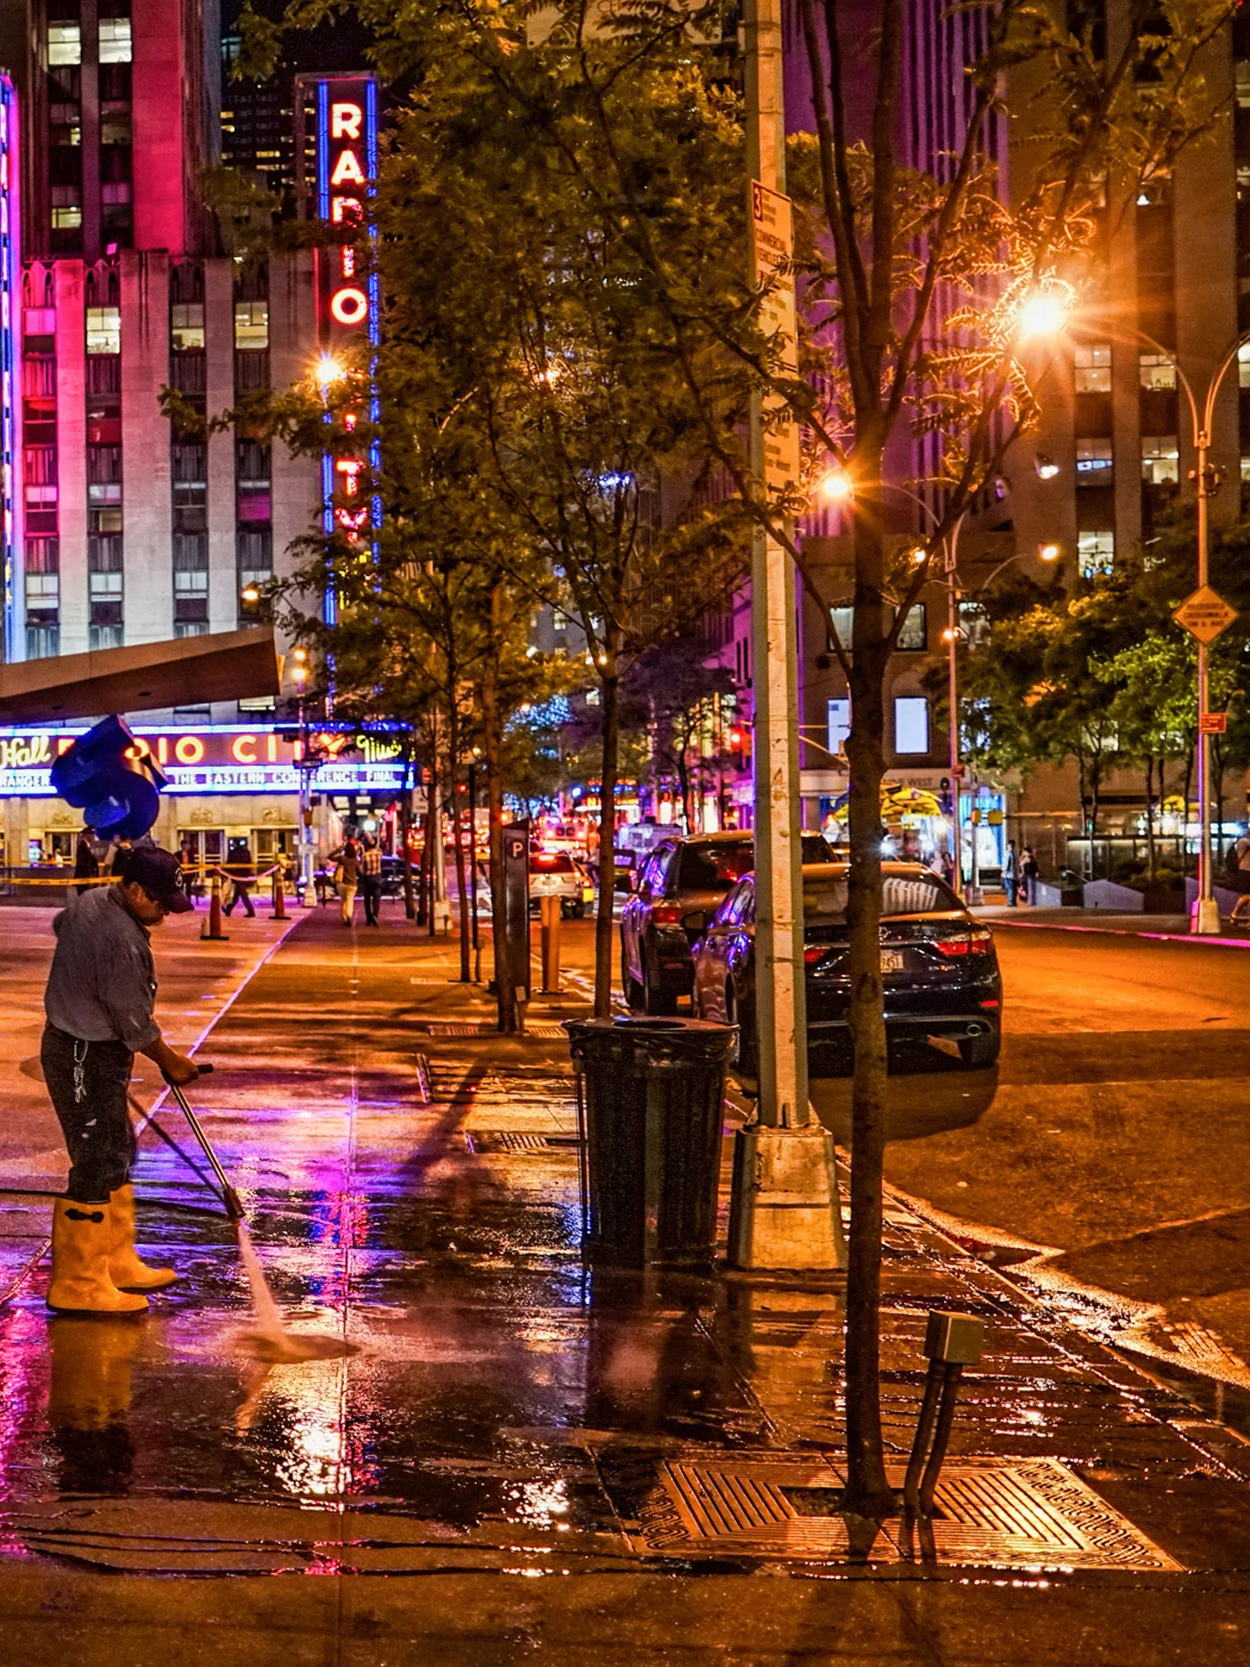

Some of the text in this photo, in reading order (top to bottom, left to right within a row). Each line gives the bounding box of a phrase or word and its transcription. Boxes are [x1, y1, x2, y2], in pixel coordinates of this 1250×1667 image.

[174, 773, 194, 785] THE
[206, 773, 264, 785] EASTERN
[272, 772, 358, 784] CONERENCE
[512, 841, 524, 858] P
